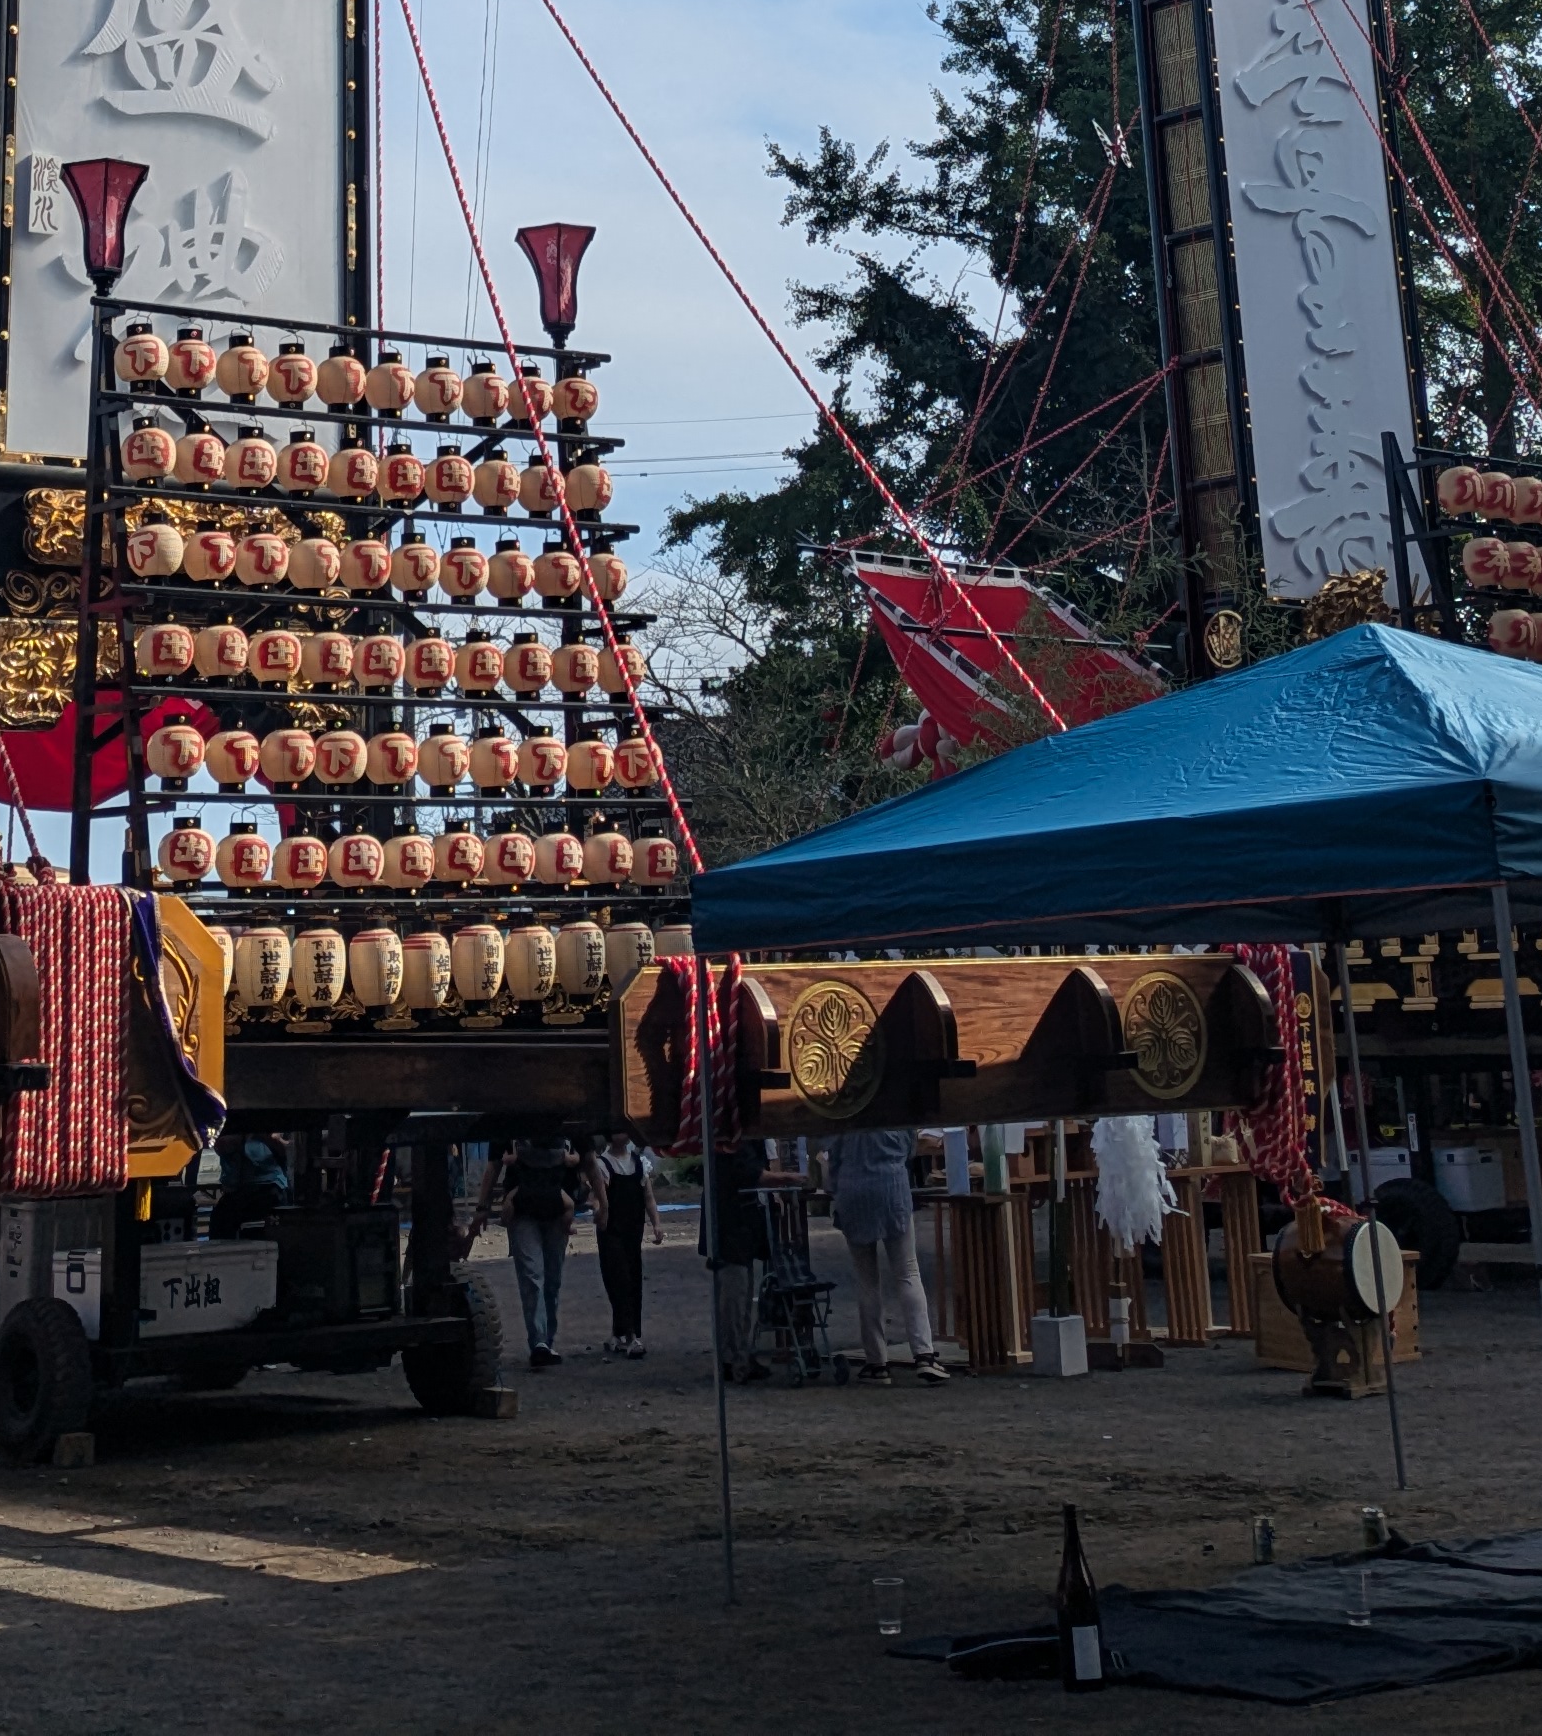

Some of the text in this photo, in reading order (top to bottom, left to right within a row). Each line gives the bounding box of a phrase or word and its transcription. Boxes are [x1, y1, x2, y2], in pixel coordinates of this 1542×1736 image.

[125, 344, 157, 373] 下
[179, 344, 211, 374] 下
[241, 352, 267, 383] 下
[279, 361, 311, 391] 下
[432, 373, 462, 403] 下
[568, 382, 595, 408] 下
[131, 432, 165, 465] 出
[199, 440, 225, 470] 出
[243, 446, 273, 481] 出
[295, 447, 325, 482] 出
[353, 453, 378, 487] 出
[396, 461, 421, 487] 出
[441, 460, 470, 493] 出
[126, 531, 154, 567] 下
[209, 537, 235, 568] 下
[253, 538, 285, 571] 下
[359, 545, 390, 579] 下
[407, 547, 437, 578] 下
[451, 554, 486, 586] 下
[159, 632, 191, 665] 出
[223, 633, 249, 668] 出
[266, 638, 297, 668] 出
[328, 641, 354, 676] 出
[368, 643, 401, 677] 出
[420, 643, 450, 677] 出
[474, 649, 502, 679] 出
[525, 650, 553, 679] 出
[575, 651, 598, 679] 出
[169, 733, 200, 766] 下
[232, 739, 259, 771] 下
[287, 738, 315, 771] 下
[321, 740, 355, 774] 下
[387, 740, 415, 772] 下
[443, 743, 470, 776] 下
[535, 746, 566, 777] 下
[619, 748, 651, 780] 下
[173, 834, 209, 869] 出
[240, 845, 269, 874] 出
[297, 845, 325, 876] 出
[348, 841, 378, 876] 出
[405, 842, 433, 872] 出
[453, 838, 481, 868] 出
[502, 838, 533, 875] 出
[562, 841, 583, 871] 出
[258, 951, 281, 1001] 世話係
[311, 952, 335, 1001] 世話係
[163, 1273, 222, 1309] 下出組
